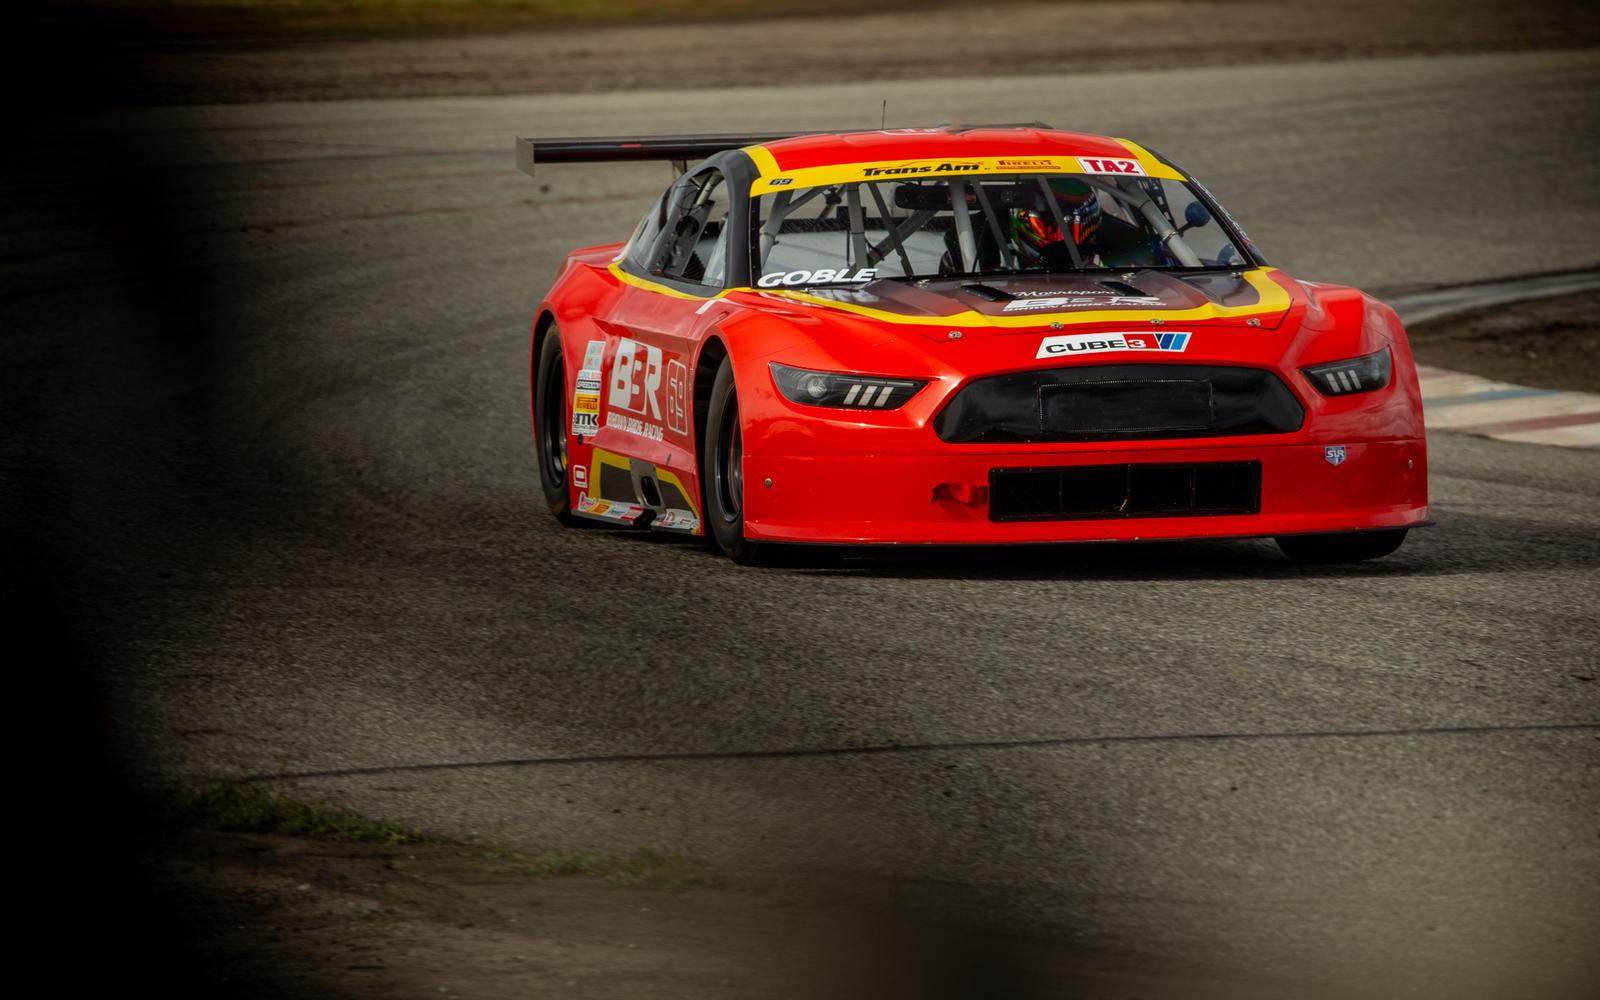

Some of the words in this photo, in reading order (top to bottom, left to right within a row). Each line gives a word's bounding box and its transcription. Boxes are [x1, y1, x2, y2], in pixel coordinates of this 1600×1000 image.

[863, 165, 931, 176] Trans
[934, 163, 979, 172] Am
[1084, 159, 1140, 174] TA2
[757, 268, 879, 288] GOBLE
[1045, 338, 1147, 354] CUBE3
